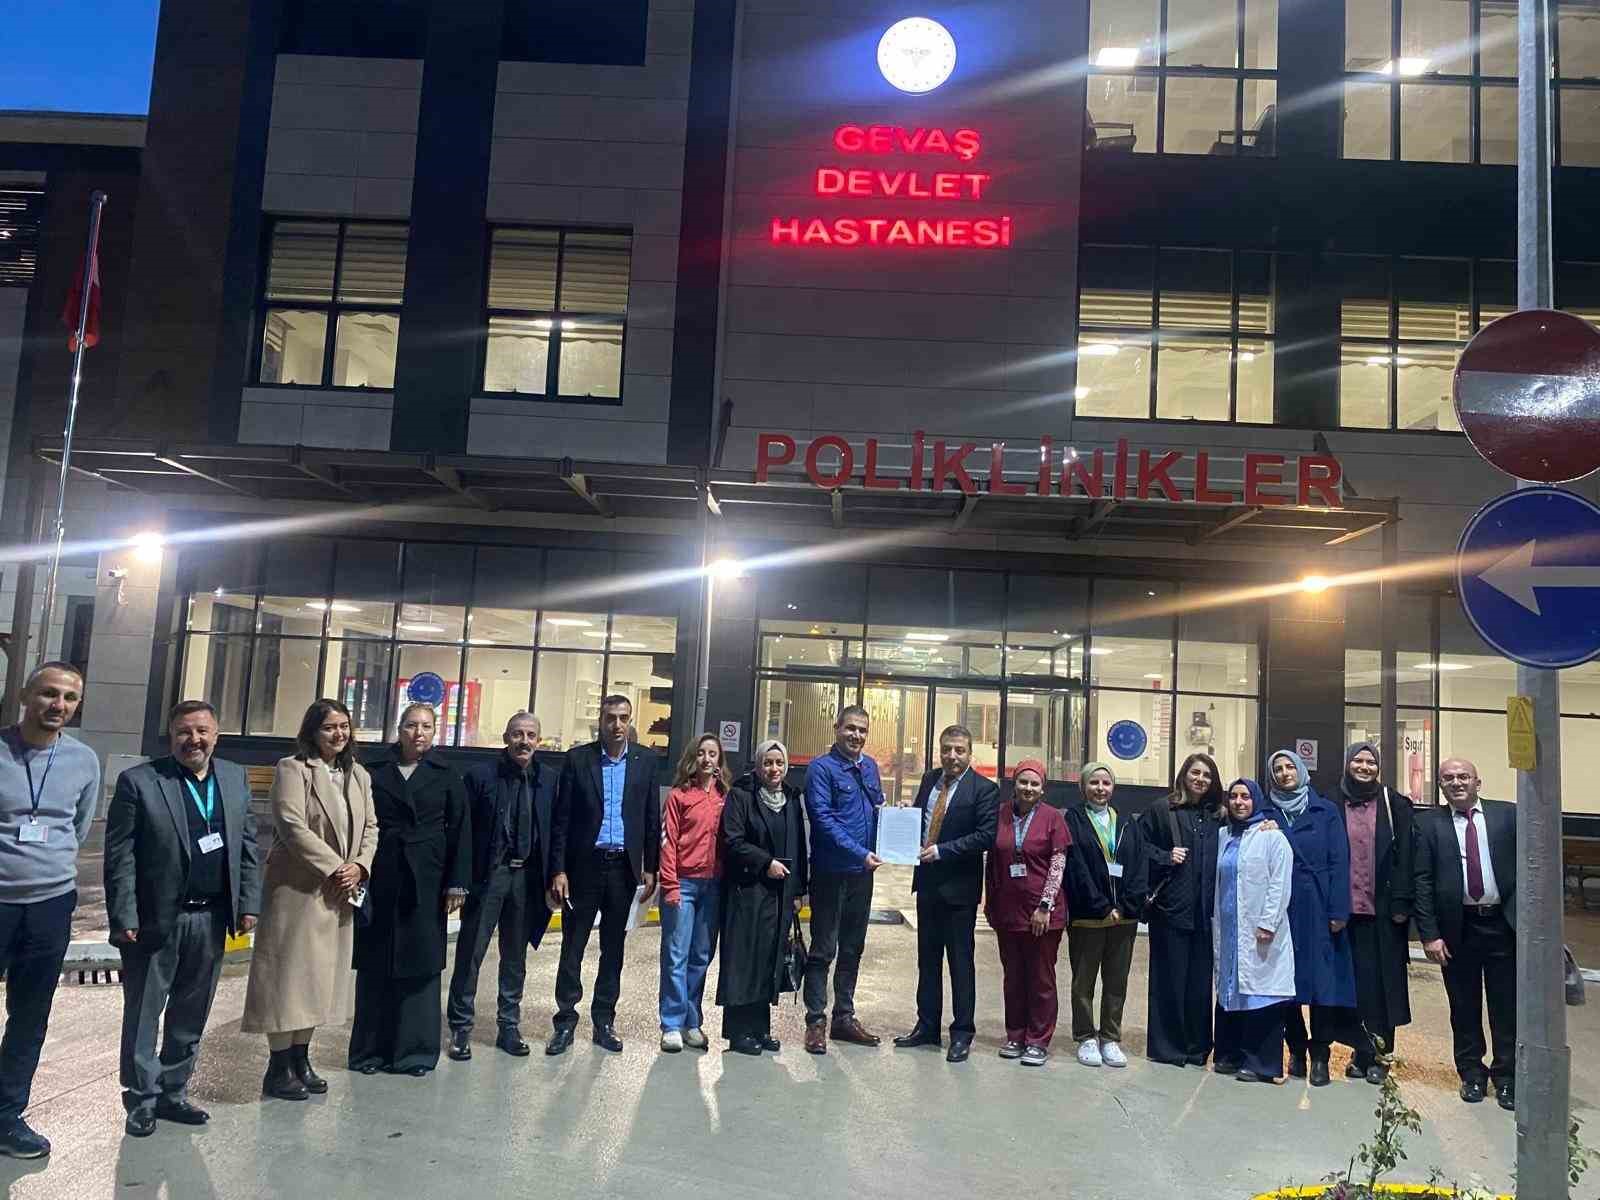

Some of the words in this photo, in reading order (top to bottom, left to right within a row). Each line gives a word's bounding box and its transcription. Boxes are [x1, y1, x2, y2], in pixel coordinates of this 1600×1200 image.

[835, 125, 981, 160] GEVAŞ
[817, 168, 990, 199] DEVLET
[771, 216, 1010, 246] HASTANESİ
[755, 430, 1344, 510] POLİKLİNİKLER
